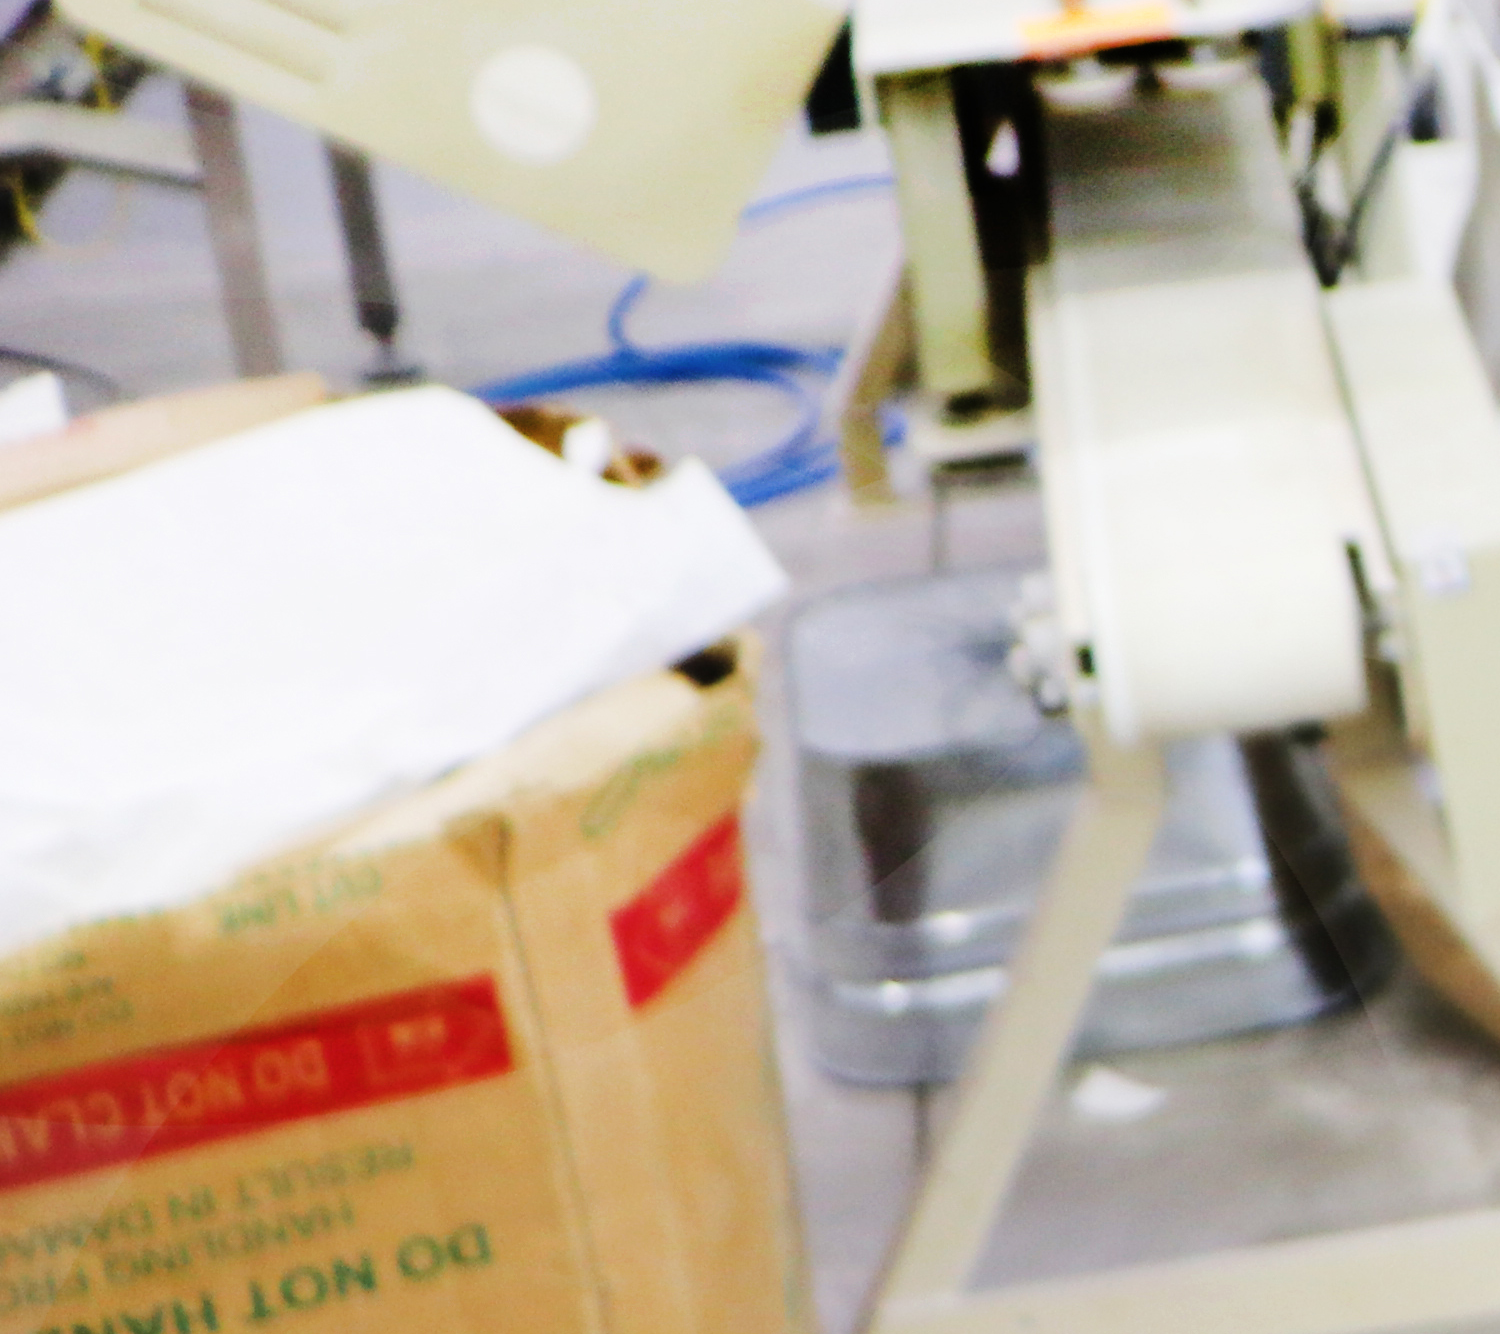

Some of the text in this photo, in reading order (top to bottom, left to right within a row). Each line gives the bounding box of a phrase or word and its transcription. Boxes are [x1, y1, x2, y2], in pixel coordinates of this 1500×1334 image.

[142, 1063, 246, 1124] NOT
[251, 1037, 328, 1095] DO
[396, 1222, 493, 1285] DO
[247, 1249, 379, 1327] NOT
